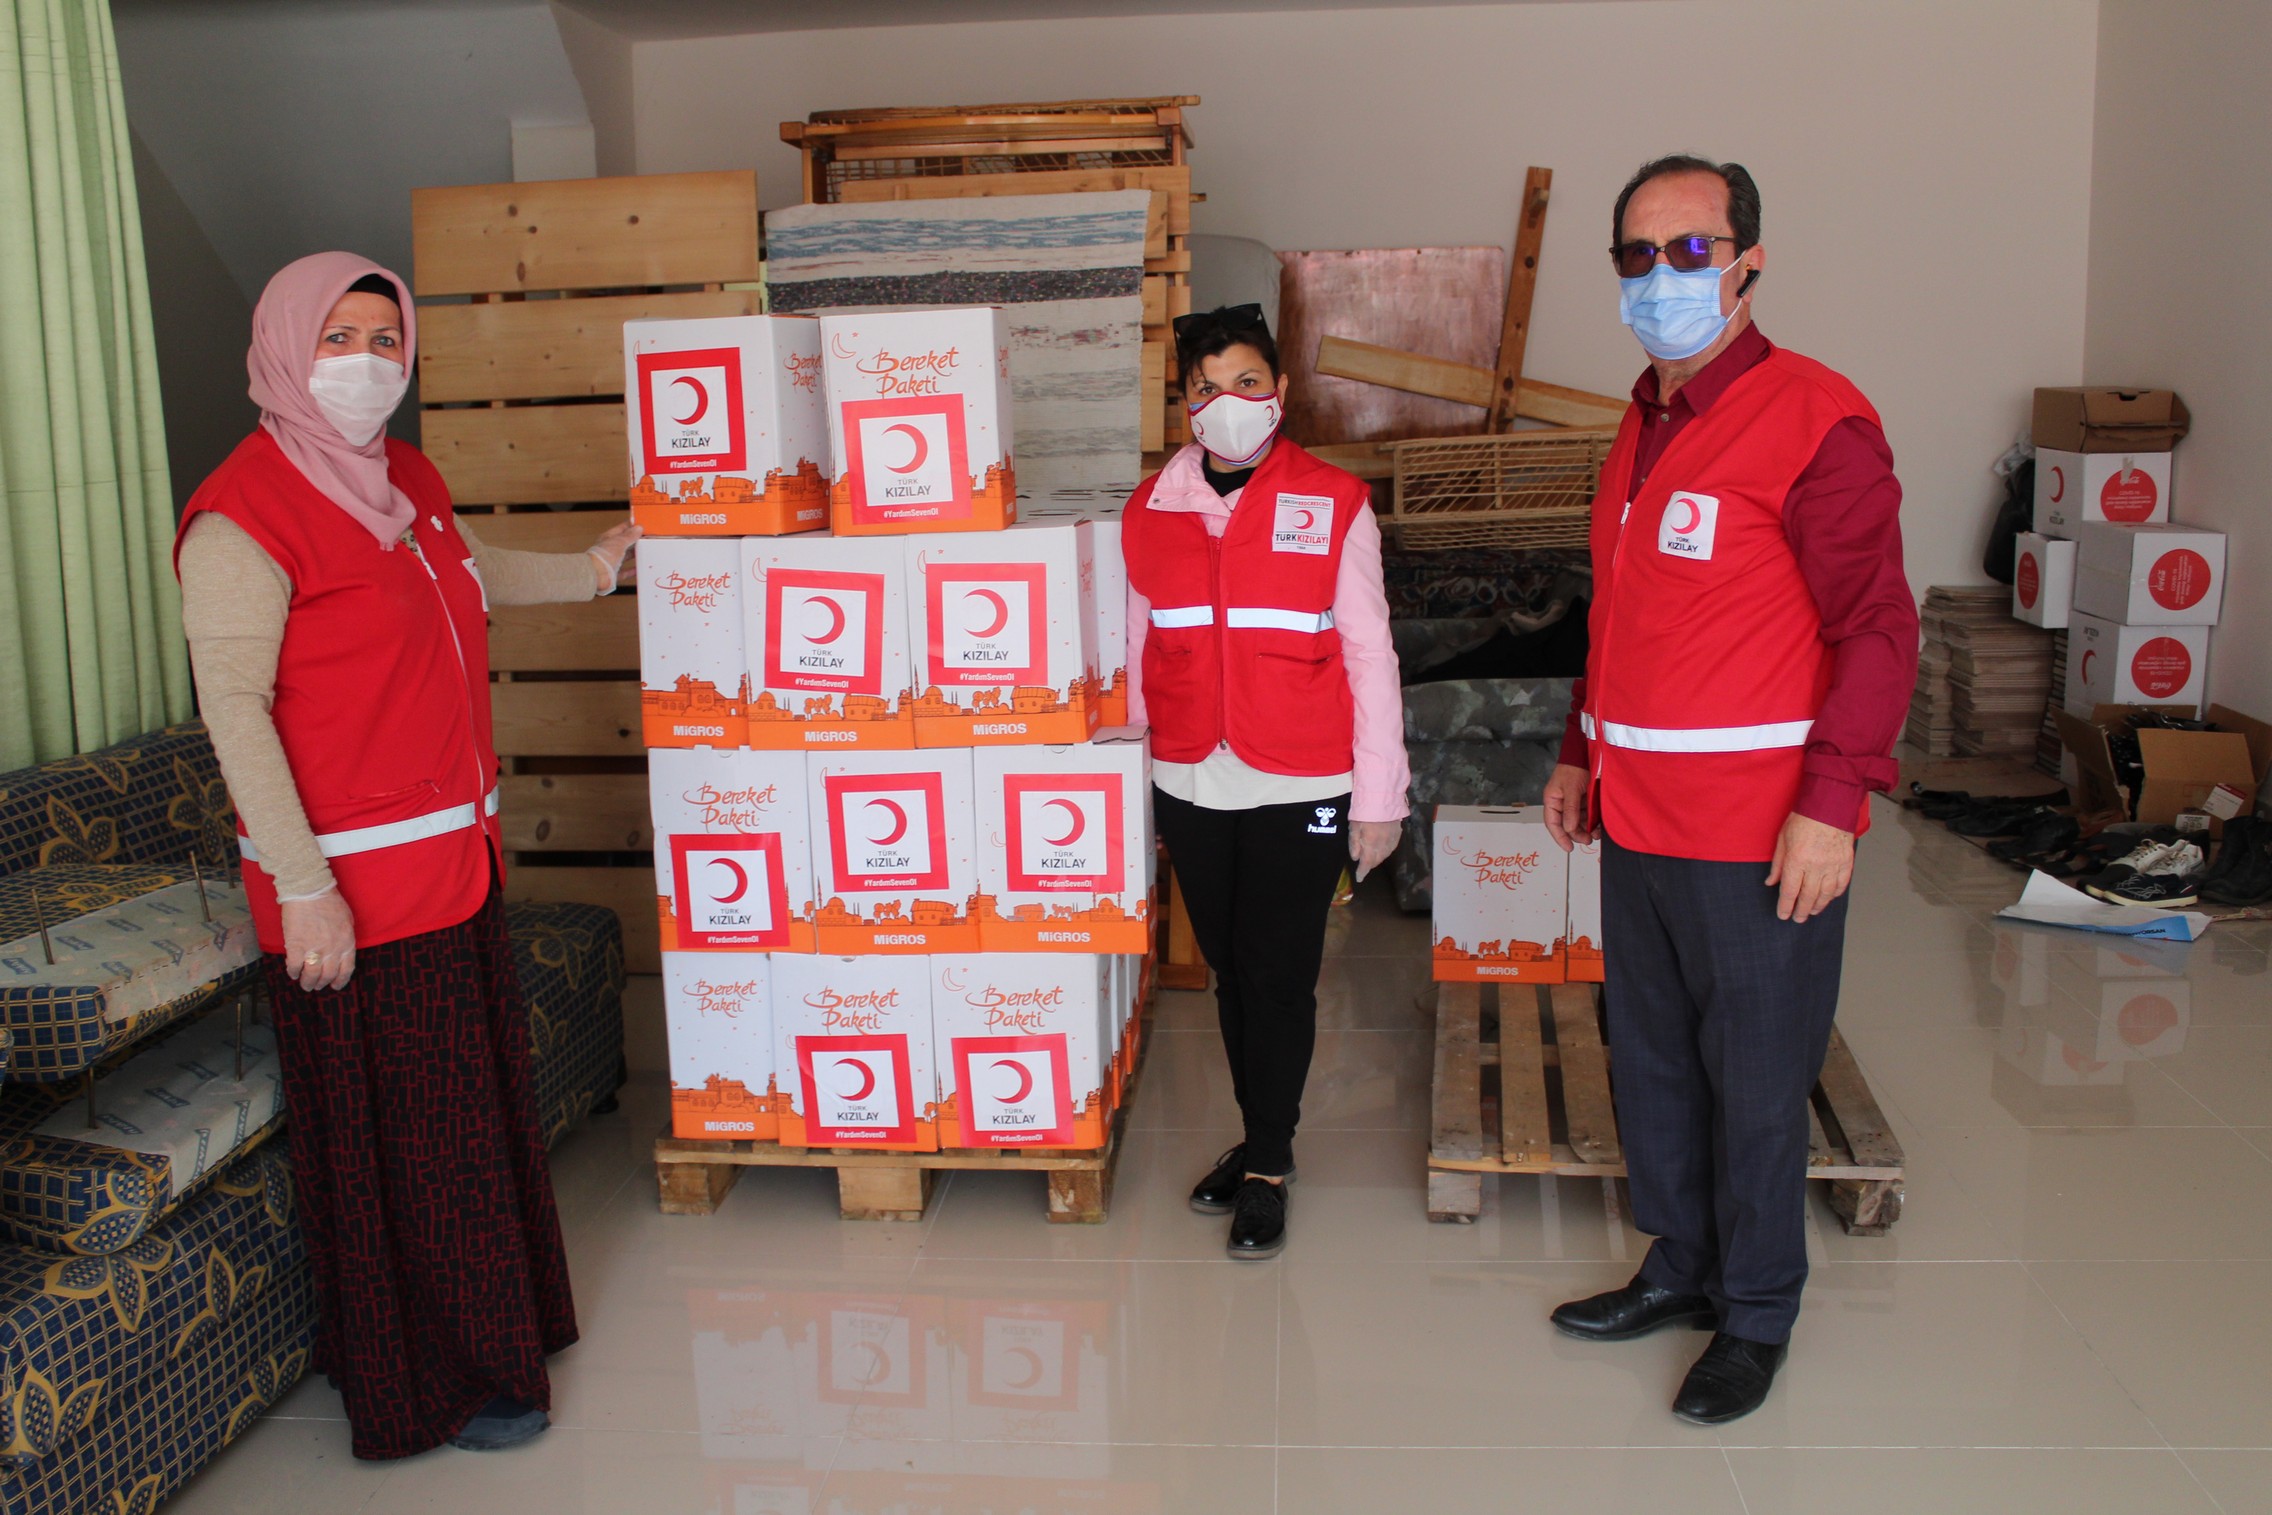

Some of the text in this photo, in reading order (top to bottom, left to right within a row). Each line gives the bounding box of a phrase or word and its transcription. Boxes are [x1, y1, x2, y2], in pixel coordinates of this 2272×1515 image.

[856, 347, 959, 376] Bereket
[876, 373, 941, 399] Paketi
[671, 436, 711, 448] KIZILAY
[682, 429, 700, 437] TÜRK
[886, 485, 931, 498] KIZILAY
[898, 478, 918, 486] TÜRK
[1668, 541, 1698, 552] KIZILAY
[655, 570, 731, 595] Bereket
[669, 589, 717, 613] Paketi
[963, 650, 1009, 661] KIZILAY
[976, 642, 996, 650] TÜRK
[799, 656, 844, 668] KIZILAY
[682, 781, 777, 811] Bereket
[700, 805, 760, 834] Paketi
[866, 857, 910, 868] KIZILAY
[1041, 858, 1086, 869] KIZILAY
[1460, 849, 1540, 873] Bereket
[1474, 867, 1524, 890] Paketi
[709, 915, 751, 925] KIZILAY
[682, 978, 758, 1001] Bereket
[803, 985, 900, 1015] Bereket
[965, 983, 1064, 1013] Bereket
[697, 996, 744, 1018] Paketi
[821, 1007, 882, 1036] Paketi
[983, 1006, 1046, 1036] Paketi
[837, 1112, 879, 1121] KIZILAY
[992, 1114, 1036, 1126] KIZILAY
